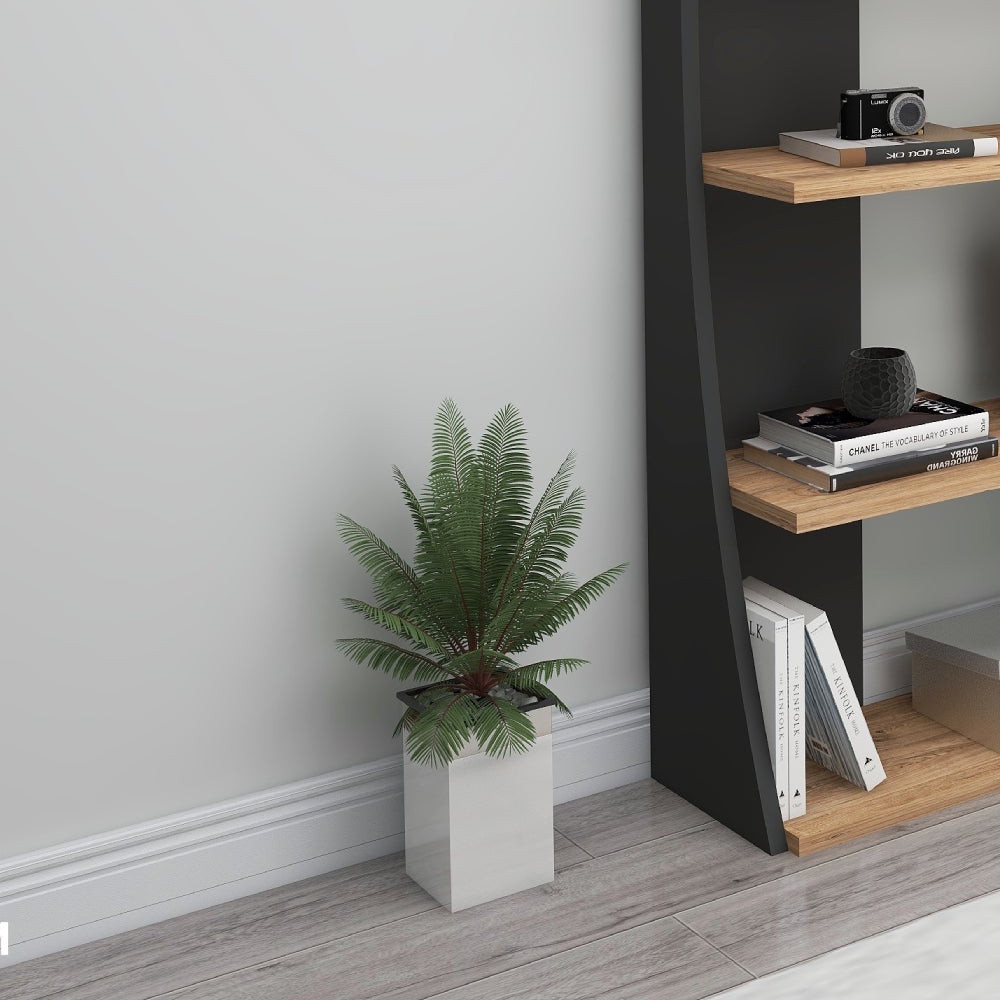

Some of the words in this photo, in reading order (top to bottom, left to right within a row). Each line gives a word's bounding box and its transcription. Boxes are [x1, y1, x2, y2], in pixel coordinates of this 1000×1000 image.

[848, 443, 880, 457] CHANEL
[882, 441, 893, 449] THE
[895, 432, 938, 447] VOCABULARY
[940, 428, 948, 437] OF
[949, 425, 969, 436] STYLE
[833, 675, 855, 720] KINFOLK
